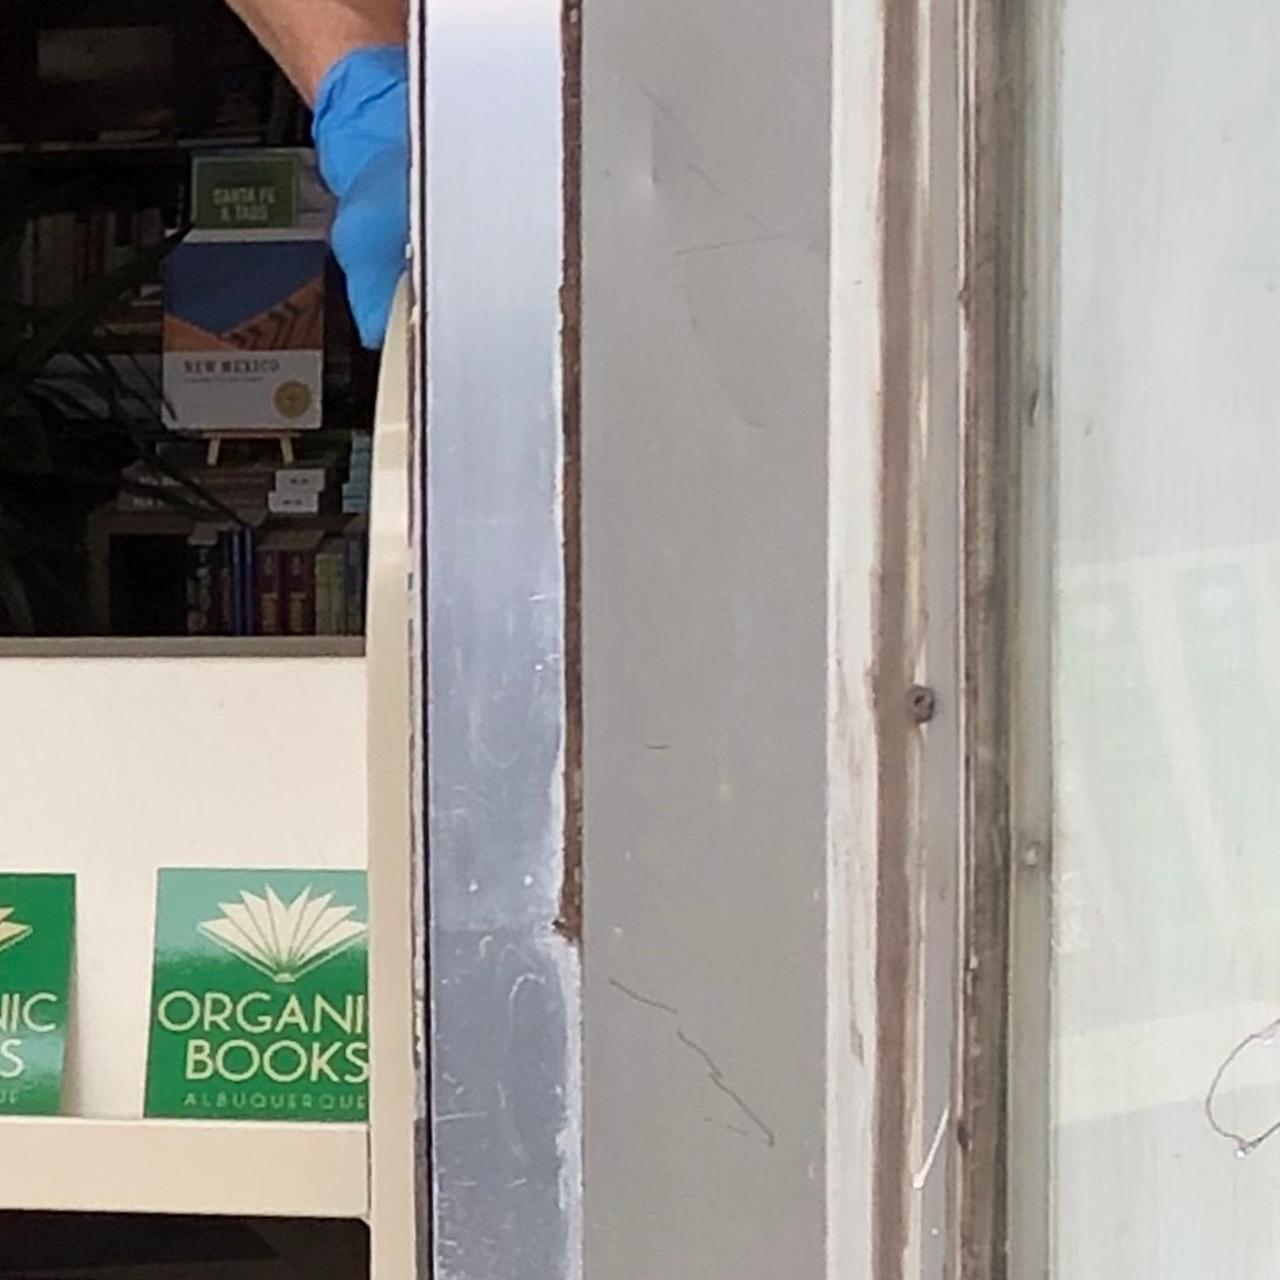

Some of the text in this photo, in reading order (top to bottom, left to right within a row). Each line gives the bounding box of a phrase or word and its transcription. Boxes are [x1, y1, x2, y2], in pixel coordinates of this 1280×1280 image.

[184, 359, 279, 373] NEW MEXICO
[157, 990, 368, 1033] ORGANI
[185, 1040, 369, 1083] BOOKS
[183, 1090, 367, 1111] ALBUQUERQUE
